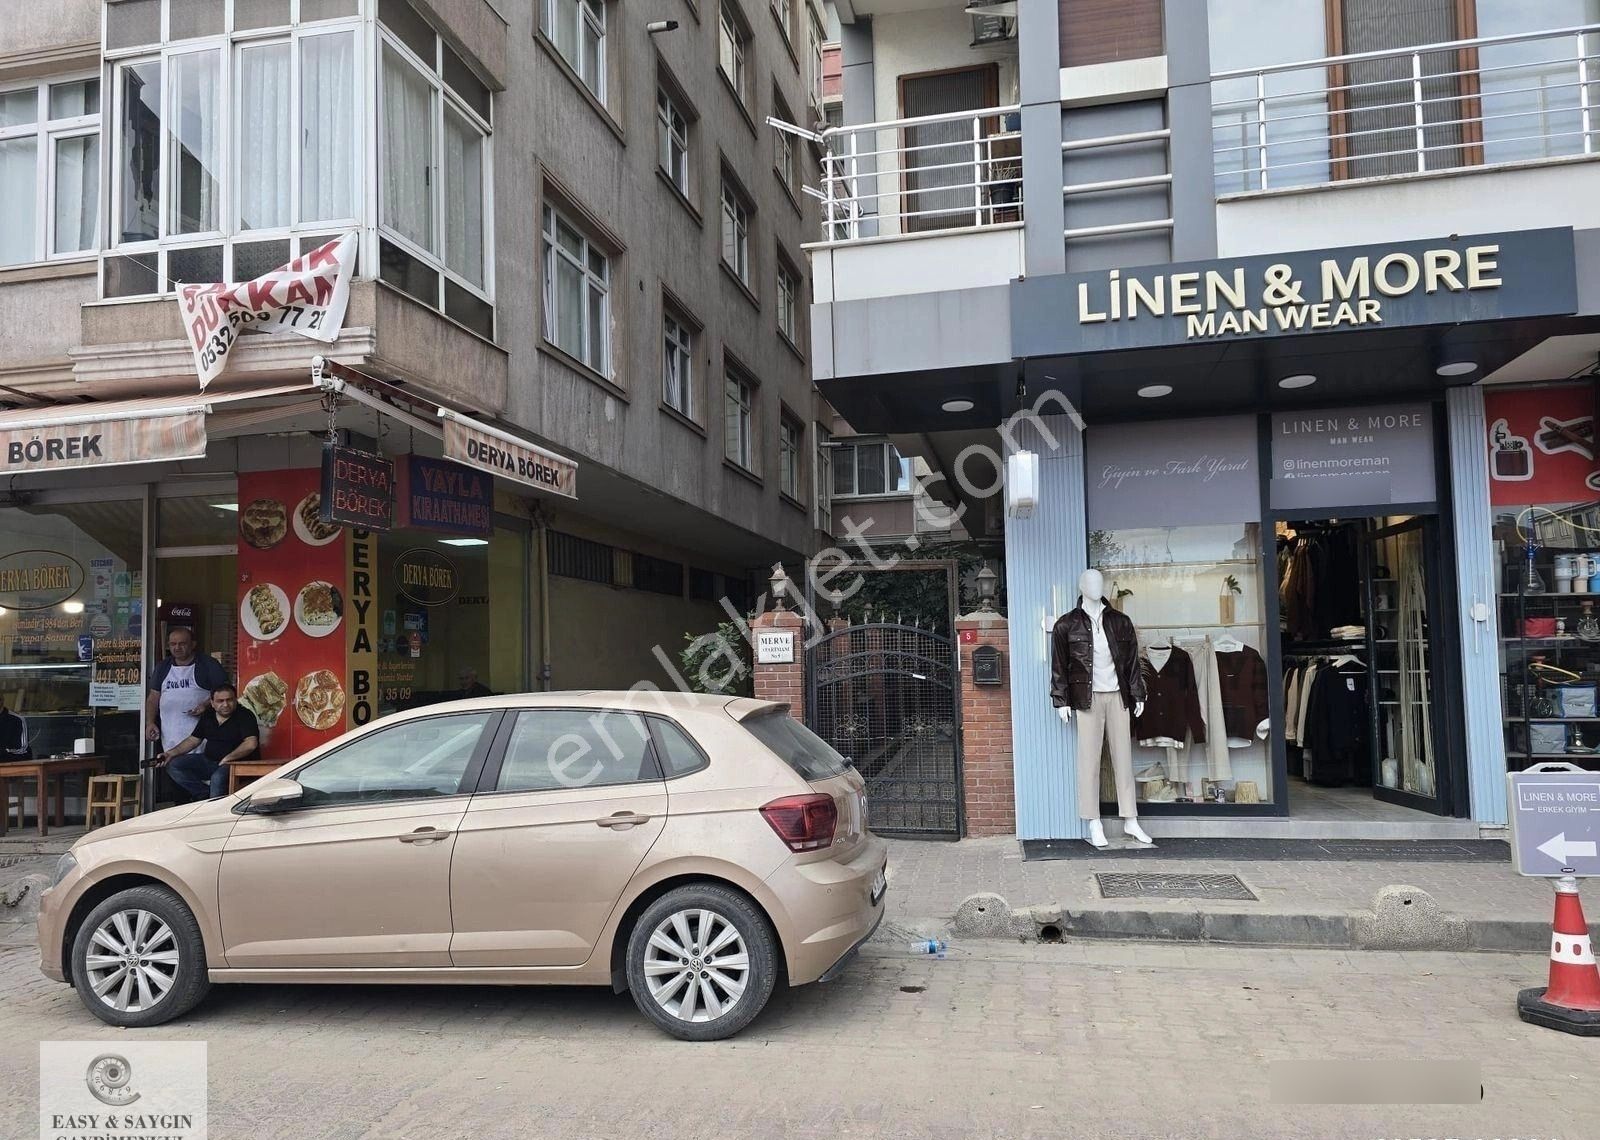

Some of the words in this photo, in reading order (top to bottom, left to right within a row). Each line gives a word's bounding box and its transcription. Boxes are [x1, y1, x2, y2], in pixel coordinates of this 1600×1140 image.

[1262, 263, 1306, 307] &
[1320, 244, 1503, 302] MORE
[1186, 307, 1268, 339] MAN
[1273, 299, 1383, 332] WEAR
[201, 326, 234, 372] 0532
[278, 305, 304, 327] 77
[1282, 418, 1338, 434] LINEN
[1347, 417, 1360, 431] &
[1368, 413, 1423, 429] MORE
[8, 434, 103, 464] BÖREK
[1329, 436, 1347, 445] MAN
[1351, 435, 1375, 444] WEAR
[335, 460, 387, 488] DERYA
[467, 438, 515, 473] DERYA
[518, 456, 560, 488] BÖREK
[1296, 455, 1390, 470] linenmoreman
[420, 465, 483, 499] YAYLA
[335, 488, 386, 517] BÖREK
[33, 563, 70, 590] BÖREK
[403, 563, 428, 586] DERYA
[1523, 792, 1555, 802] LINEN
[1556, 793, 1565, 802] &
[1566, 792, 1598, 802] MORE
